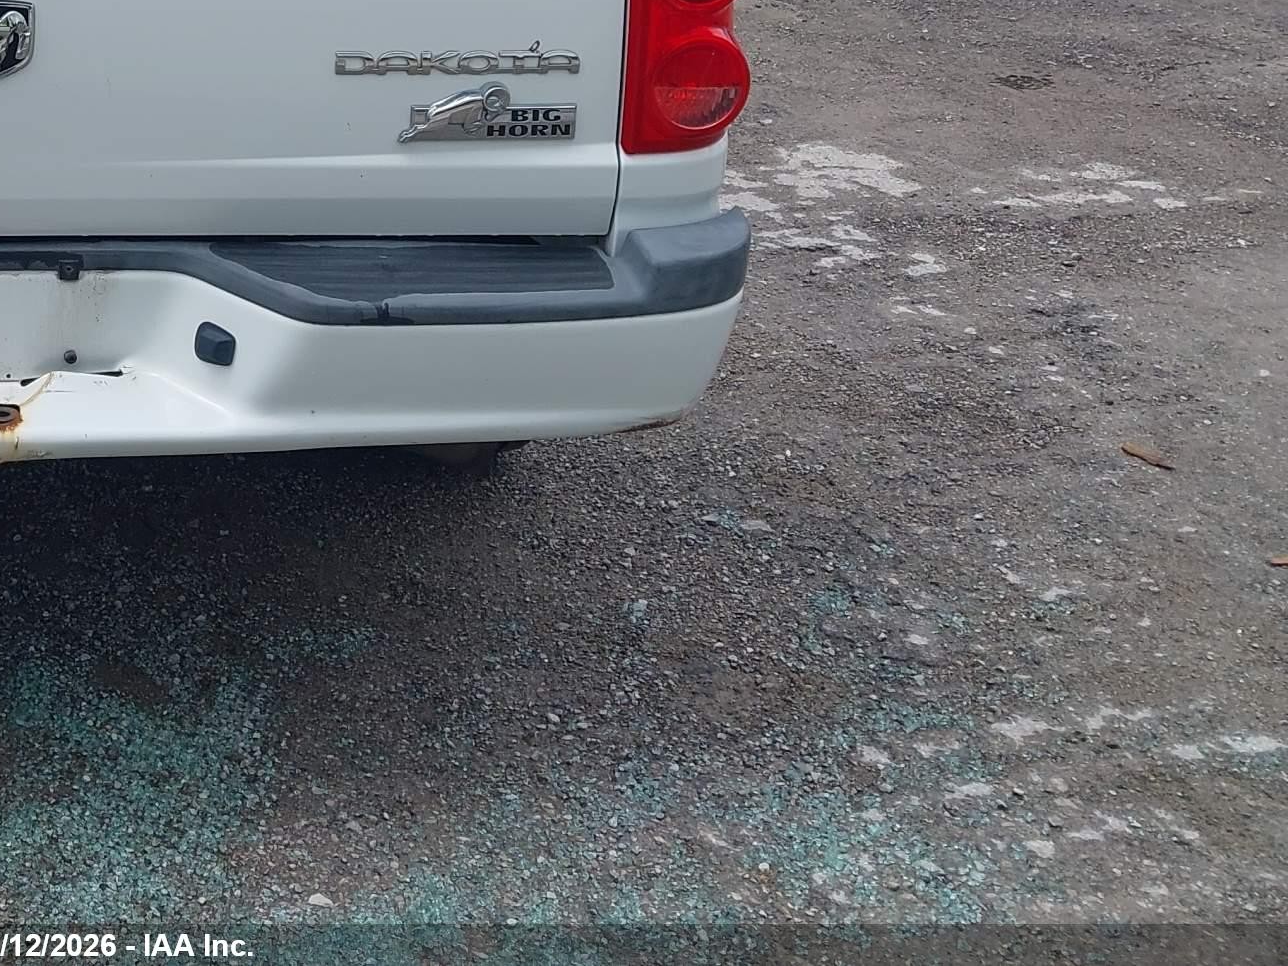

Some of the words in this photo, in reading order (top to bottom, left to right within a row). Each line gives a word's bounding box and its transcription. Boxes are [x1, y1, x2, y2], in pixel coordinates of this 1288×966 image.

[335, 48, 580, 75] DAKOTA
[511, 108, 561, 122] BIG
[486, 124, 571, 137] HORN
